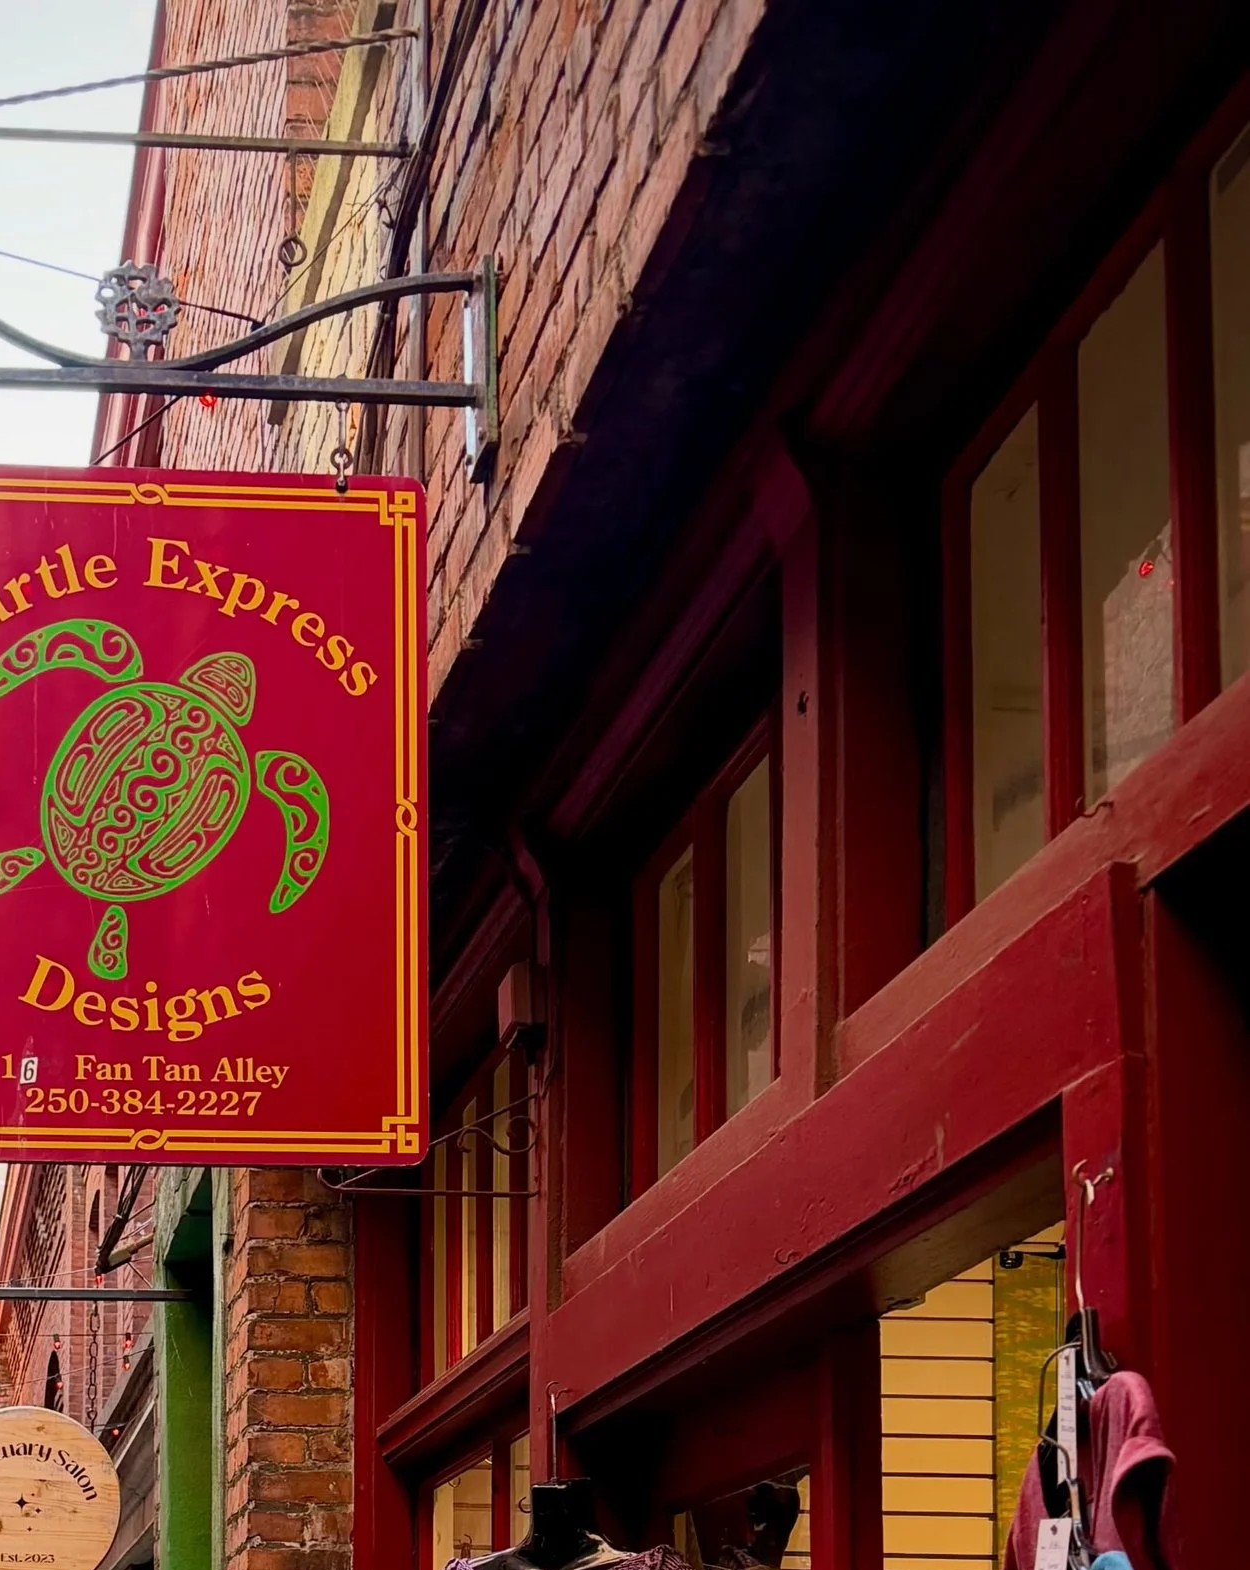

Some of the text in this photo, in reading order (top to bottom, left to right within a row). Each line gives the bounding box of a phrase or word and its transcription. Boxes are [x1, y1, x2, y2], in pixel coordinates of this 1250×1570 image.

[143, 536, 379, 697] Express
[17, 954, 271, 1042] Designs
[1, 1053, 290, 1089] 16 Fan Tan Alley
[25, 1087, 262, 1117] 250-384-2227
[53, 1449, 98, 1501] Salon
[25, 1553, 55, 1564] 2023
